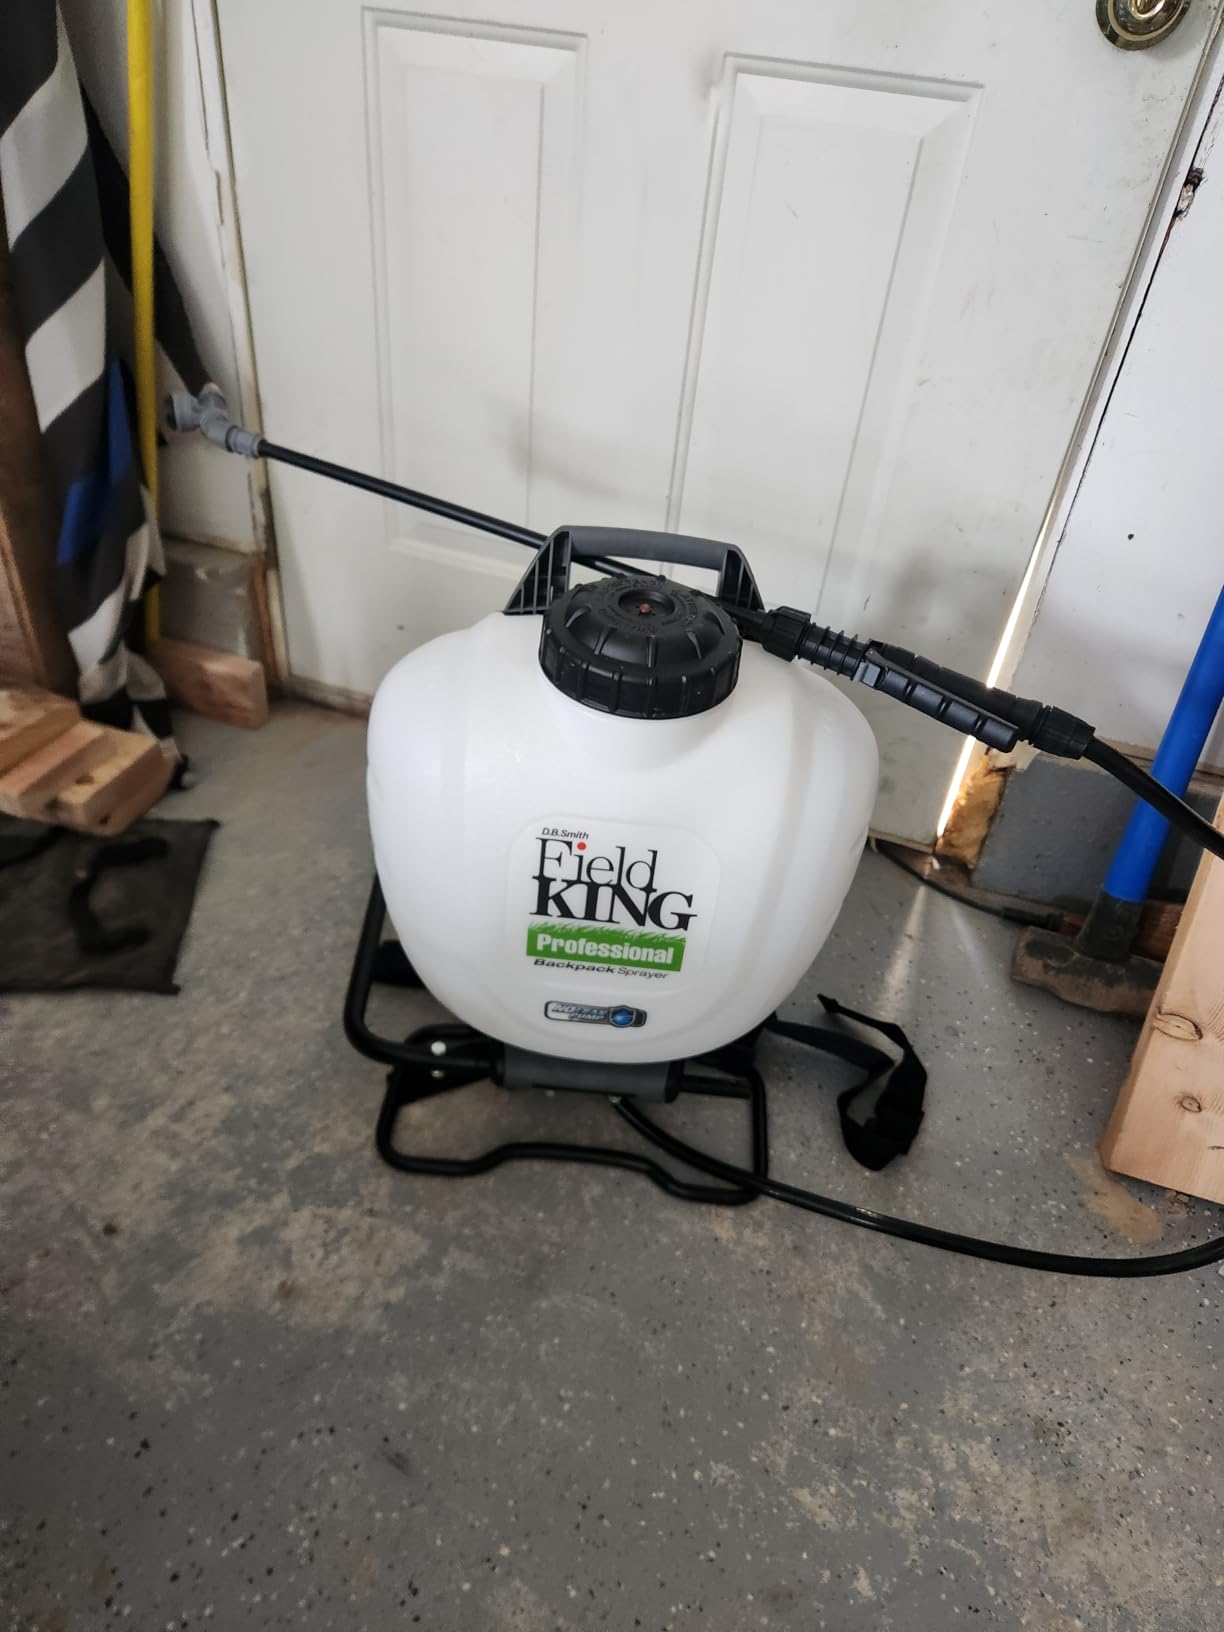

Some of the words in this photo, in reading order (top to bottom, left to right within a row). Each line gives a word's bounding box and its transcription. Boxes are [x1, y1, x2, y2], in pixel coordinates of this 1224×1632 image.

[532, 837, 658, 892] Field
[529, 877, 698, 931] KING
[533, 958, 615, 973] Backpack
[617, 967, 669, 980] Sprayer
[536, 933, 674, 964] Professional
